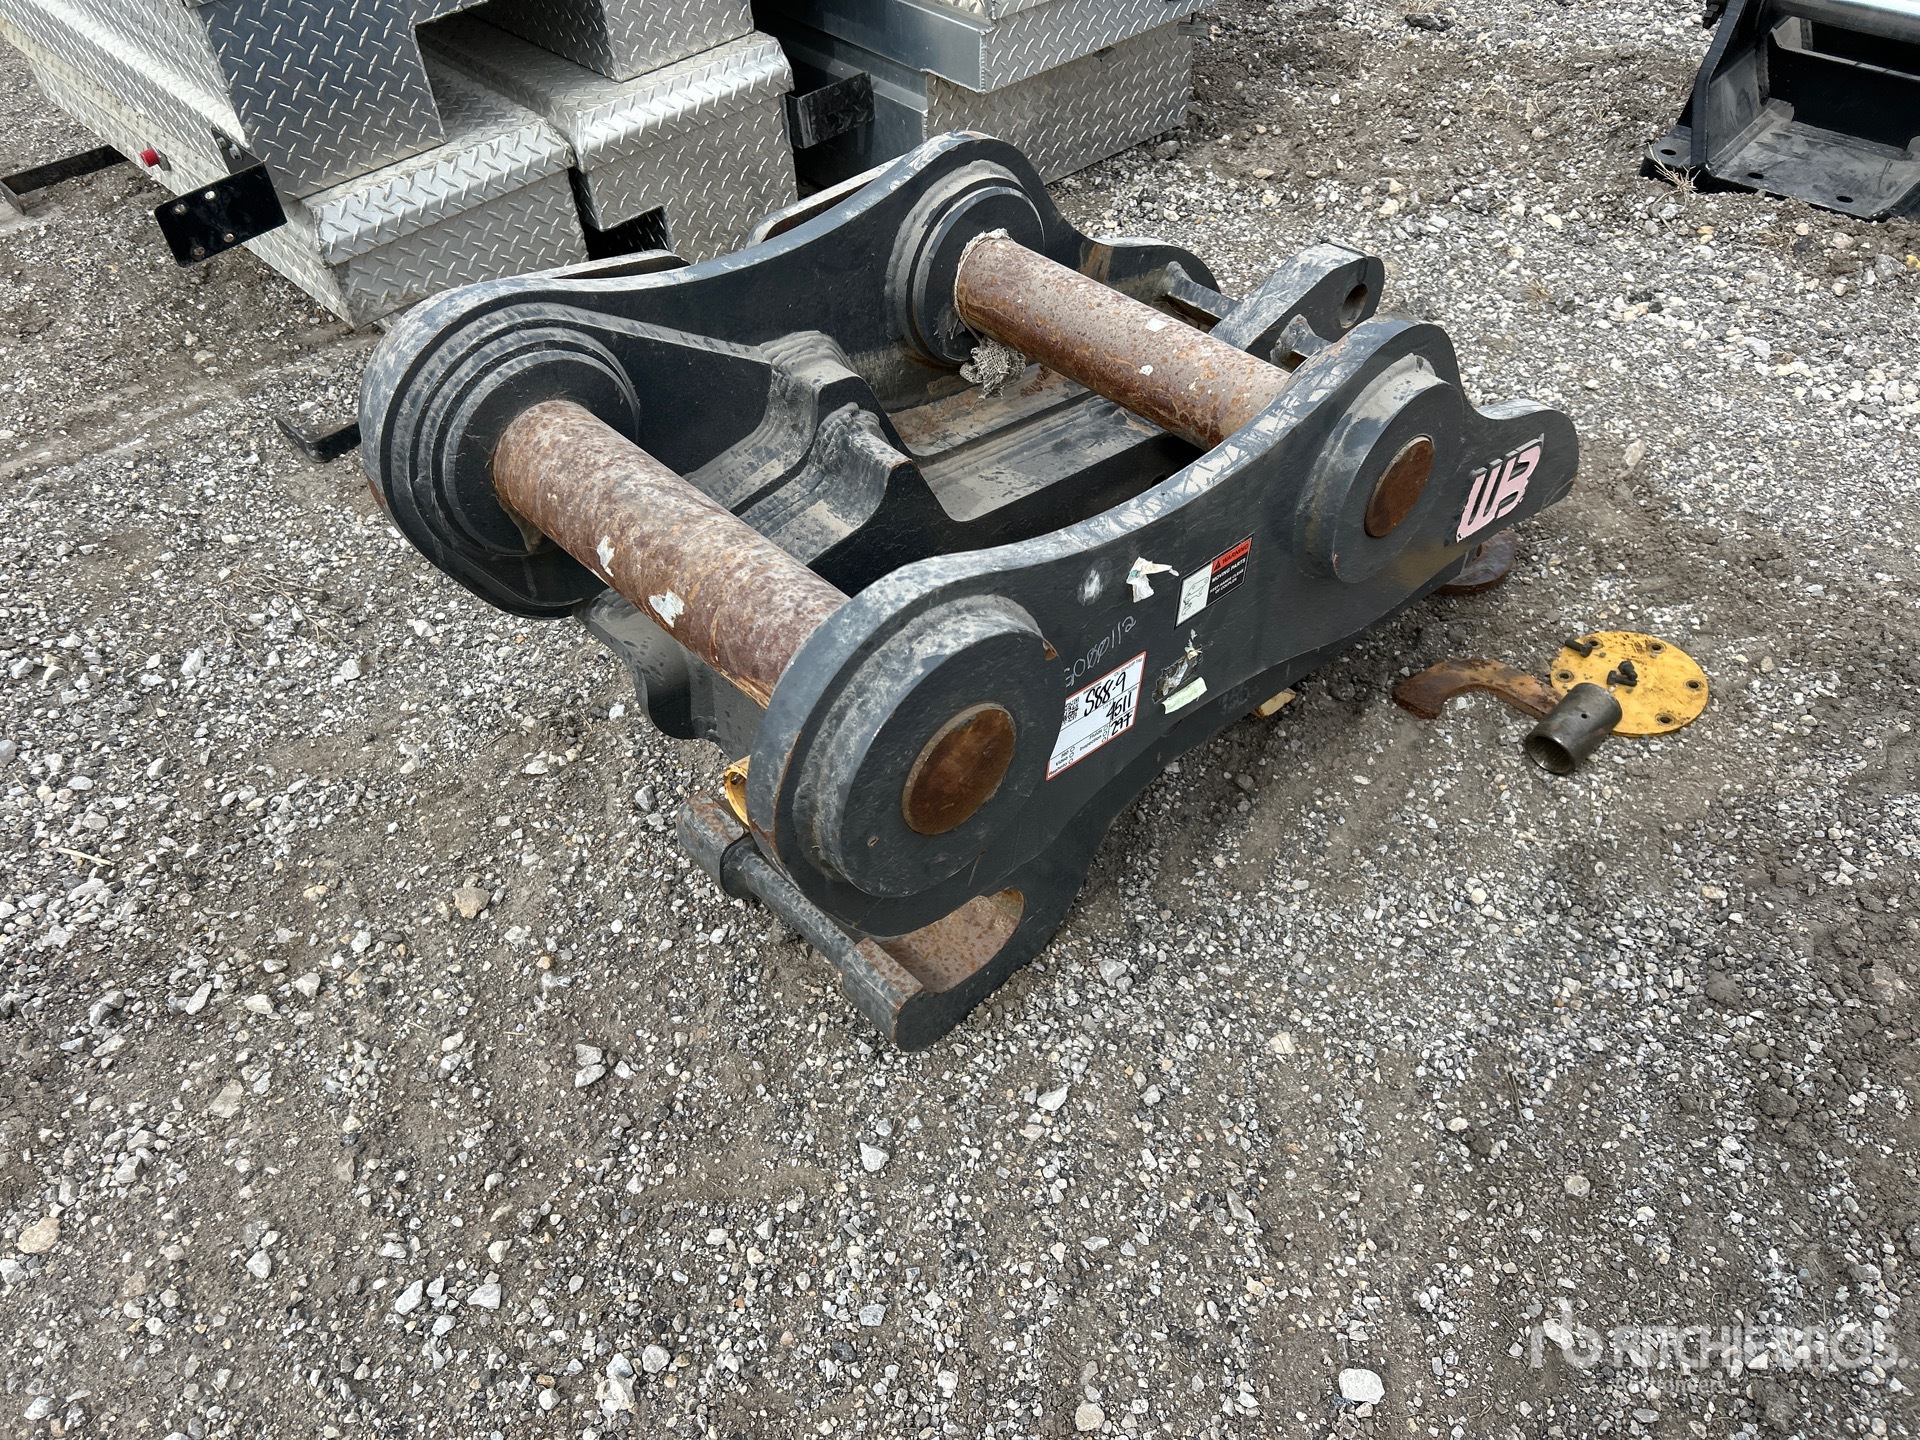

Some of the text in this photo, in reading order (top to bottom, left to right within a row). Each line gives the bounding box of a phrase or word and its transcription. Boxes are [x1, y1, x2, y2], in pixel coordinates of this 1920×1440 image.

[1222, 543, 1249, 564] WARNING
[1211, 557, 1246, 583] MOVING PARTS
[1105, 691, 1132, 720] 4511
